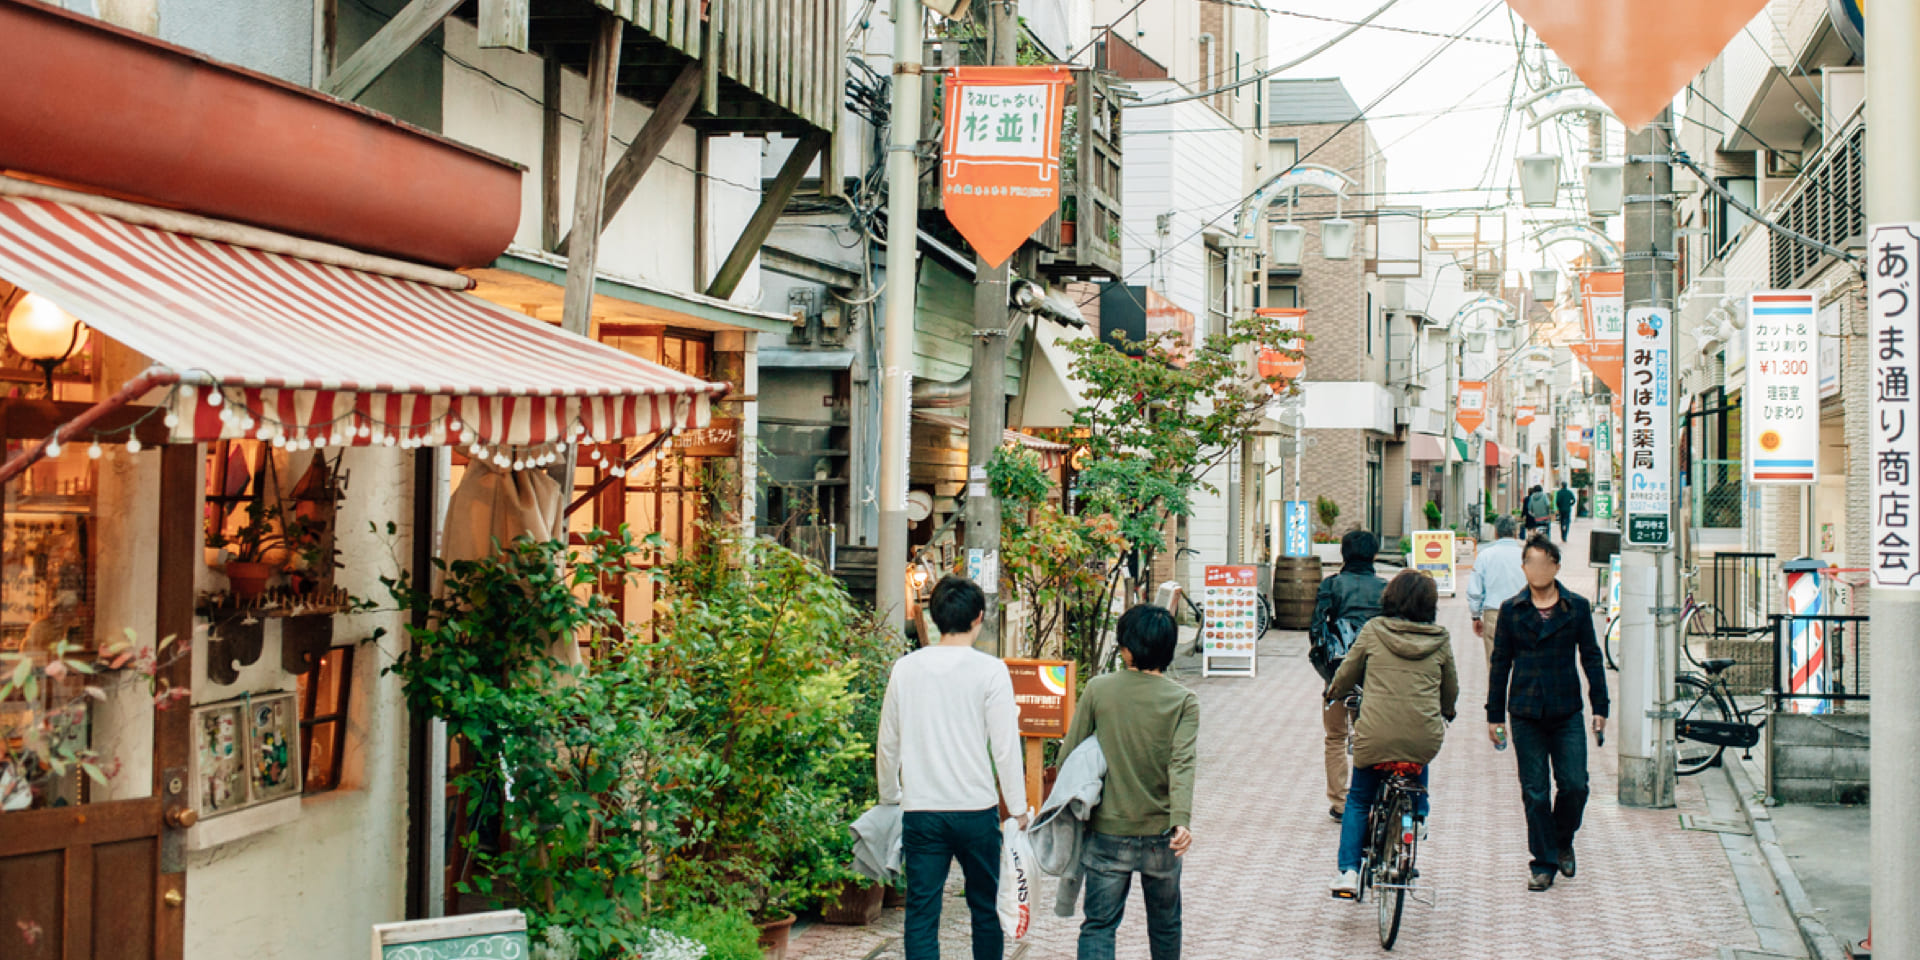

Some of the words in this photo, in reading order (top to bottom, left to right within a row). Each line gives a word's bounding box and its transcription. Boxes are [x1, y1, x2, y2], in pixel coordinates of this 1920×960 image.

[1633, 348, 1654, 470] みつばち薬局
[1763, 405, 1804, 420] ひまわり
[1767, 385, 1800, 401] 理容室
[1877, 243, 1910, 569] あづま通り商店会
